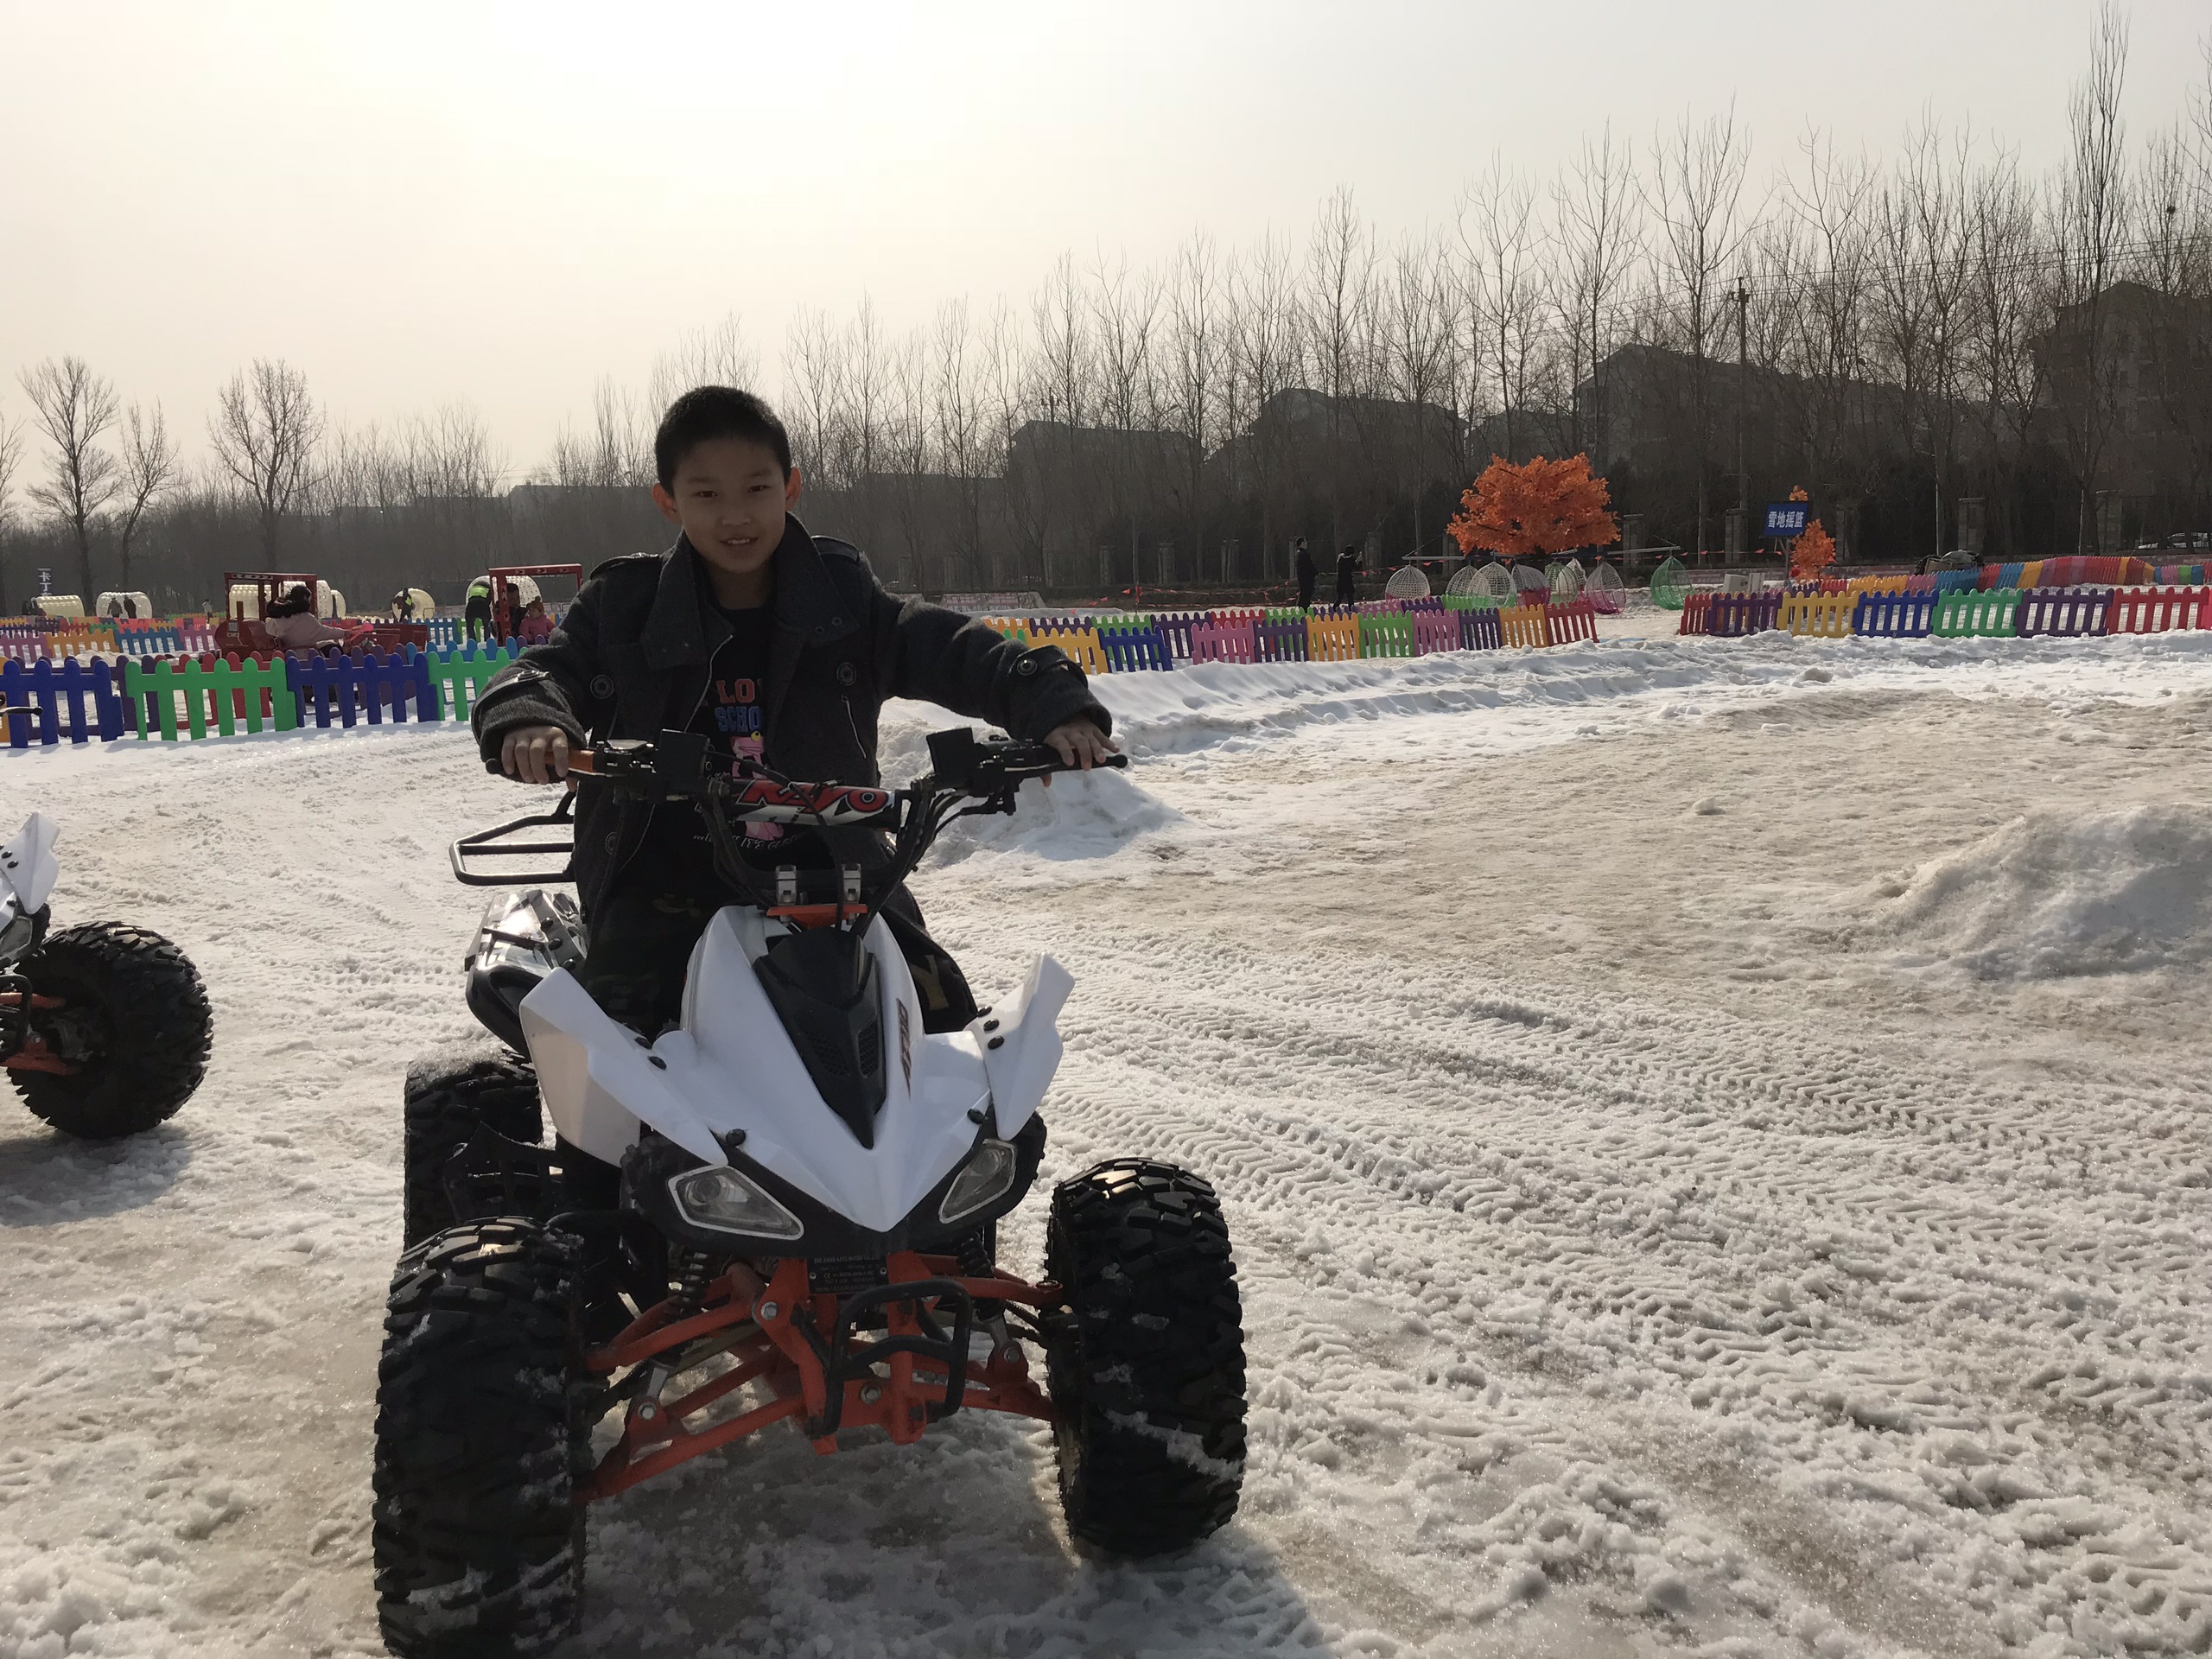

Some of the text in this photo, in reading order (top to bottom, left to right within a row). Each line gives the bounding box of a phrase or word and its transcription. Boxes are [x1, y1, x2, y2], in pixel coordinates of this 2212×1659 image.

[1768, 511, 1805, 528] 雪地摇篮
[715, 678, 762, 704] LO
